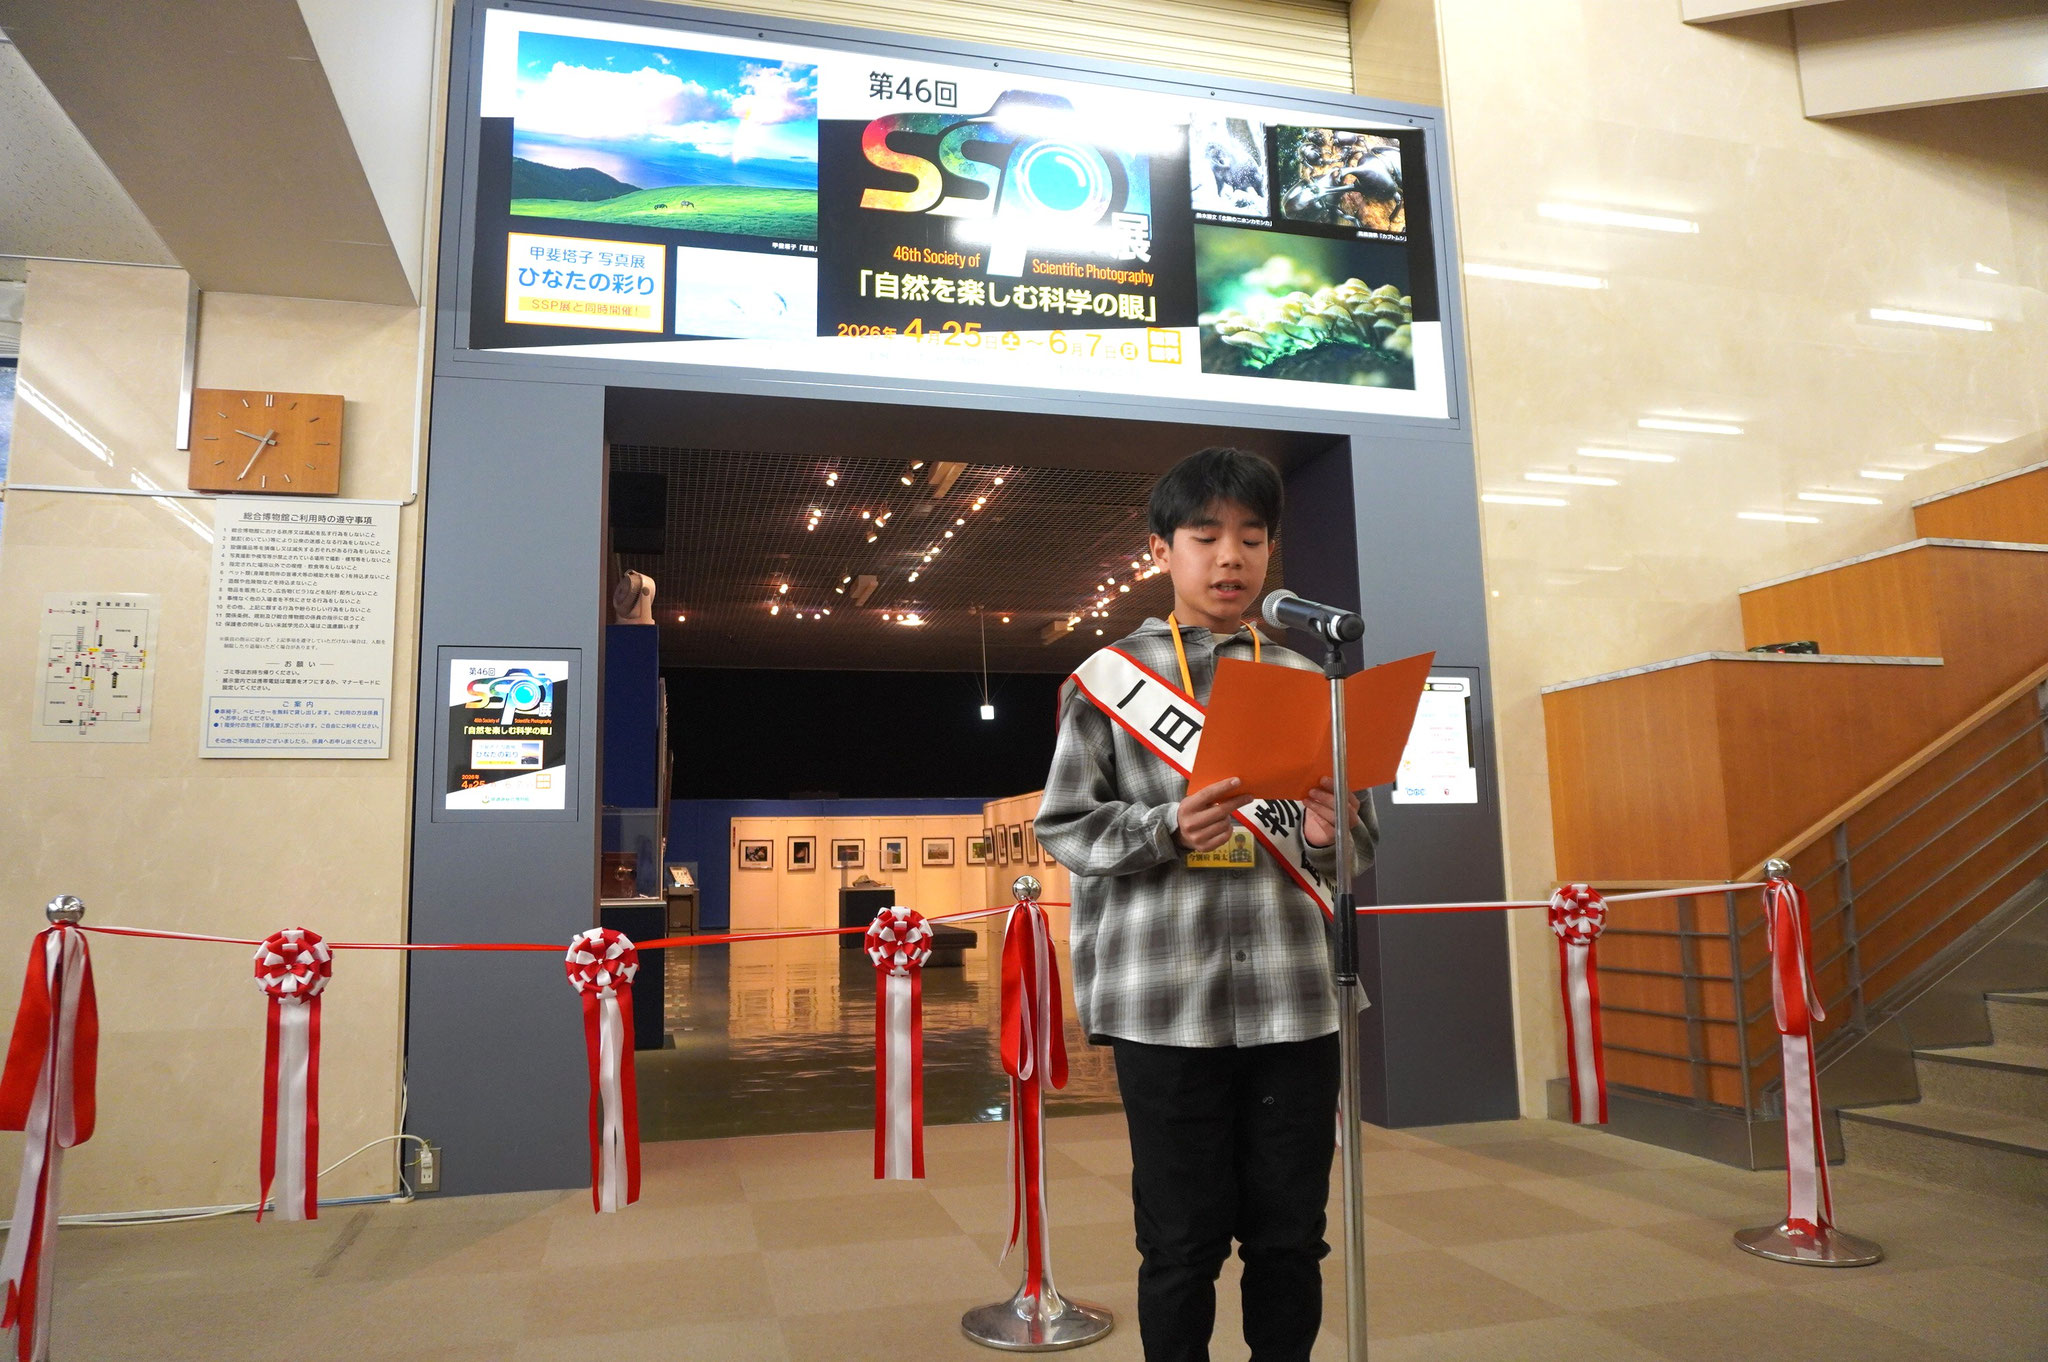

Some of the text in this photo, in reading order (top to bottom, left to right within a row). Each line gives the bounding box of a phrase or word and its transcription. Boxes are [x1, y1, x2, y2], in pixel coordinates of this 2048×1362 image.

[868, 71, 958, 109] 第46回
[530, 246, 646, 269] 甲斐塔子 写真展
[893, 246, 1155, 287] 46th Society of Scientific Photography
[518, 267, 655, 296] ひなたの彩り
[859, 269, 1158, 322] 「自然を楽しむ科学の眼」
[243, 511, 373, 525] 総合博物館ご利用時の遵守事項
[469, 667, 496, 676] 第46回
